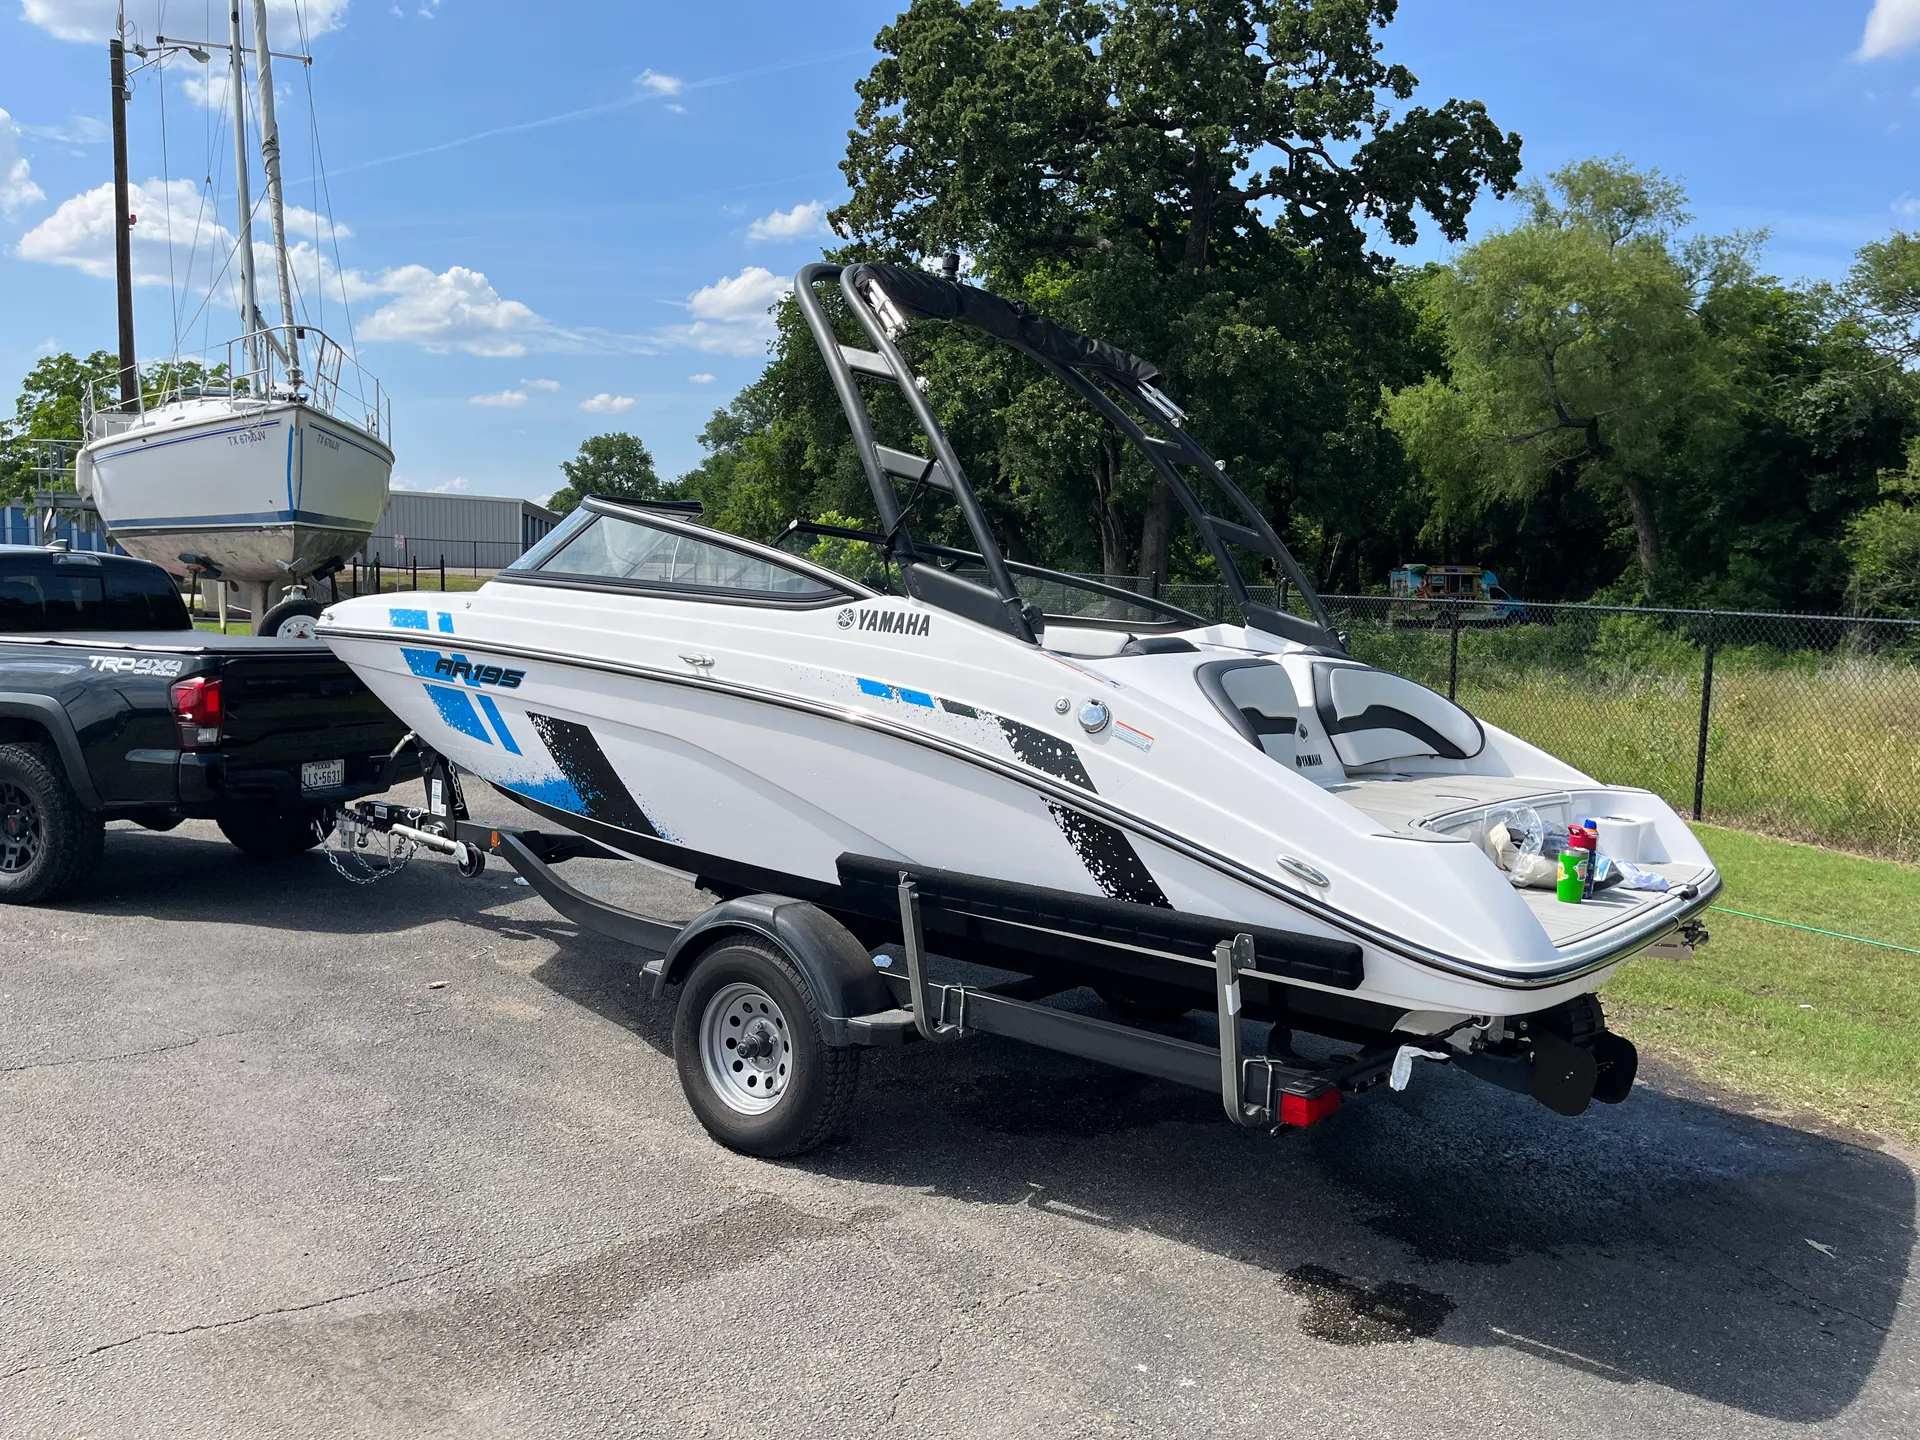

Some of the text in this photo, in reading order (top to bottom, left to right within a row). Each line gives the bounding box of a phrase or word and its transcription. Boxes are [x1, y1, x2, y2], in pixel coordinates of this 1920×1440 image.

[227, 435, 239, 447] TX
[858, 608, 931, 637] YAMAHA
[133, 668, 178, 677] OFF ROAD
[434, 658, 527, 690] AR195
